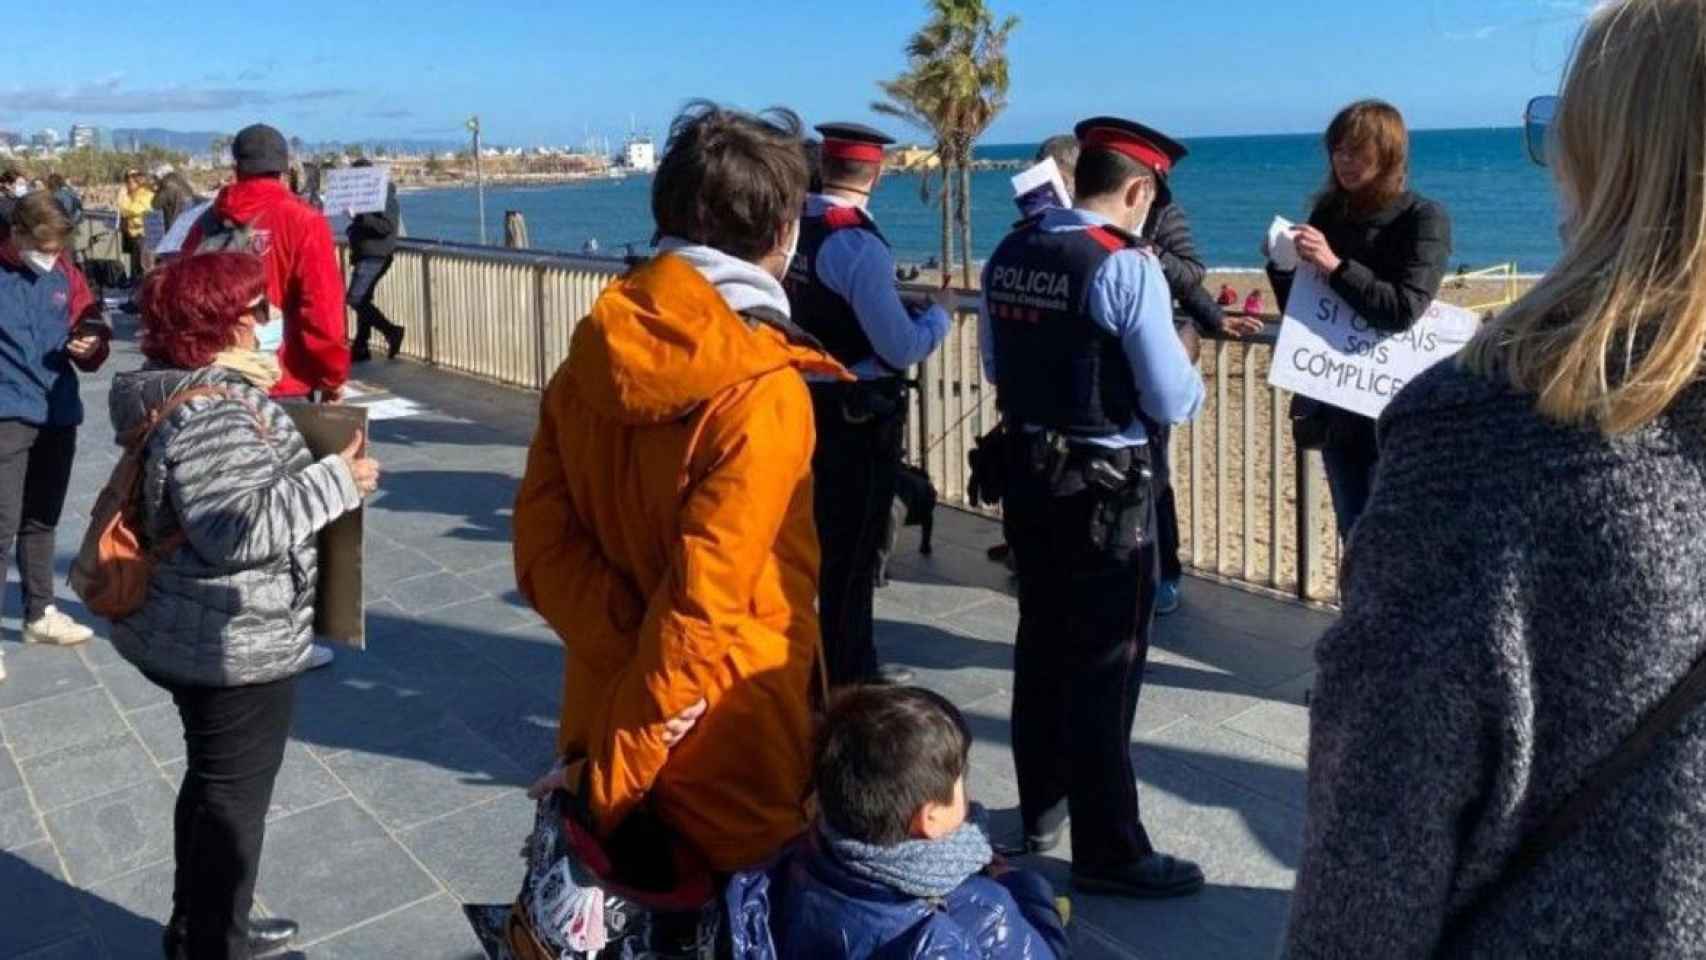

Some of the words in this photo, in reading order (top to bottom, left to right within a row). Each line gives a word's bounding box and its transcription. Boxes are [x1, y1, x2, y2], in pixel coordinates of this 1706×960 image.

[991, 265, 1070, 298] POLICIA
[1316, 297, 1339, 325] SI
[1344, 335, 1390, 365] SOIS
